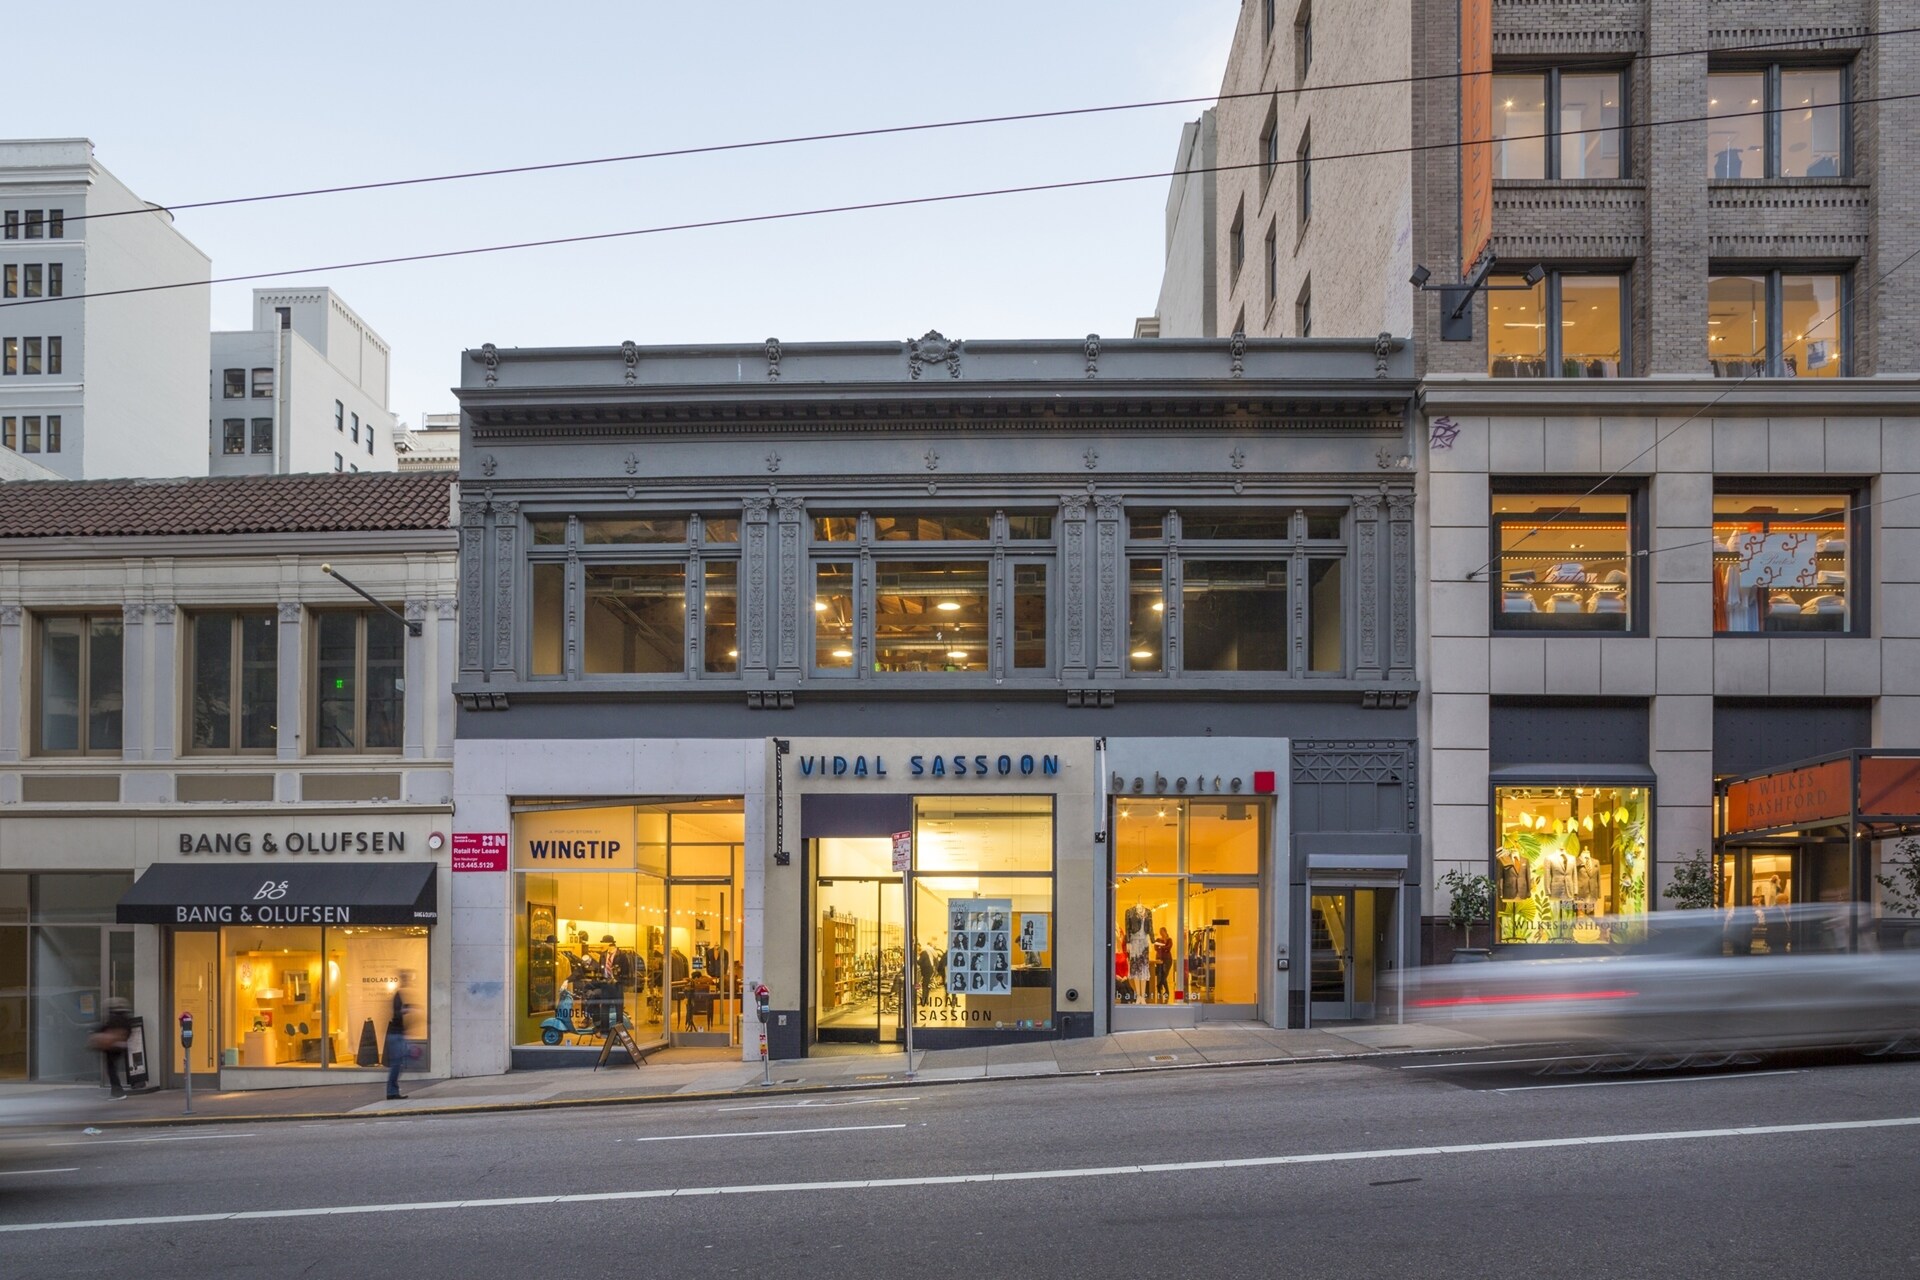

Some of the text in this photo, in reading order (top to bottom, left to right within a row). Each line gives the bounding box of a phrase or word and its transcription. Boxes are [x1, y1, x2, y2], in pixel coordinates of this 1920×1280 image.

[800, 754, 1058, 775] VIDAL SASSOON
[1111, 770, 1243, 793] babette
[1759, 771, 1815, 795] WILKES
[1748, 789, 1828, 817] BASHFORD
[179, 831, 406, 853] BANG & OLUFSEN
[529, 840, 621, 859] WINGTIP
[176, 906, 350, 923] BANG & OLUFSEN
[1514, 920, 1629, 930] WILKES BASHFORD
[919, 996, 962, 1008] VIDAL
[919, 1010, 992, 1021] SASSOON
